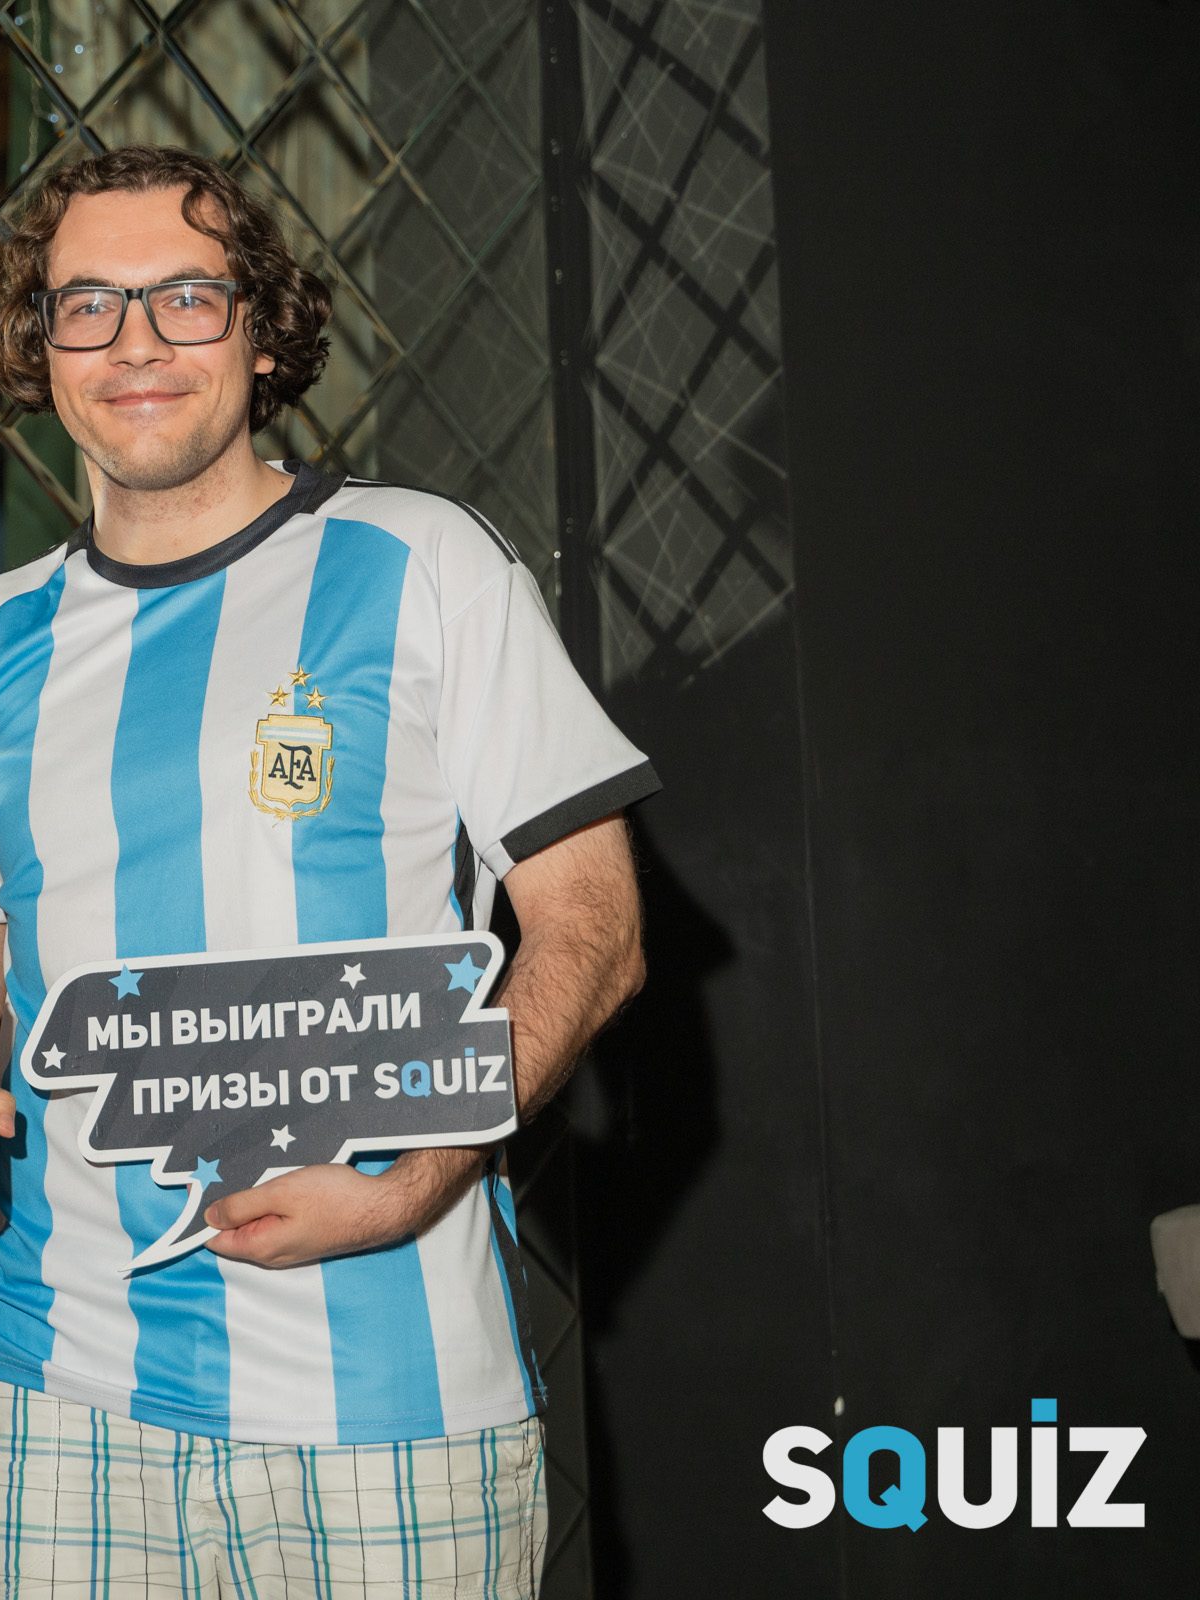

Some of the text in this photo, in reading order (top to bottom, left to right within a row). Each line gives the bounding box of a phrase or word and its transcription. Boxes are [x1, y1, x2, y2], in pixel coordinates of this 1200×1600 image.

[268, 742, 316, 790] AFA
[87, 992, 421, 1051] МЫ ВЫИГРАЛИ
[133, 1068, 290, 1115] ПРИЗЫ
[300, 1065, 357, 1104] ОТ
